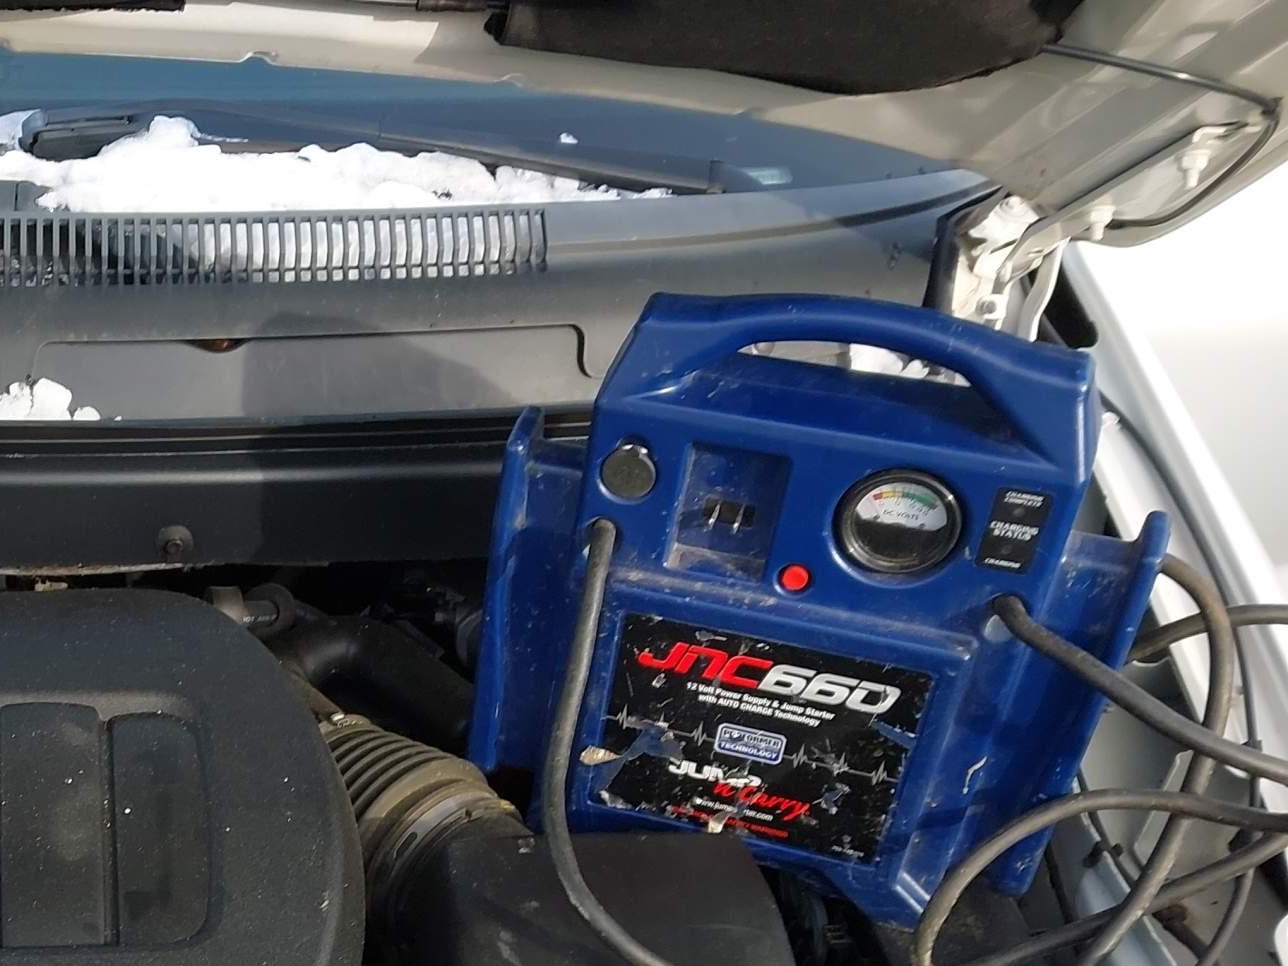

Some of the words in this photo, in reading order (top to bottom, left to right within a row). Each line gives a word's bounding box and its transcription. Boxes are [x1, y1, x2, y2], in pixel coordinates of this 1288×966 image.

[990, 520, 1040, 536] CHARGING
[993, 528, 1032, 541] STATUS
[686, 682, 697, 691] 12
[698, 683, 714, 693] Volt
[715, 687, 742, 700] Power
[743, 693, 772, 707] Supply
[772, 699, 780, 708] &
[780, 701, 805, 714] Jump
[805, 705, 836, 720] Starter
[698, 693, 717, 704] with
[717, 696, 739, 709] AUTO
[740, 700, 773, 716] CHARGE
[774, 708, 821, 727] Technology
[720, 741, 778, 760] TECHNOLOGY
